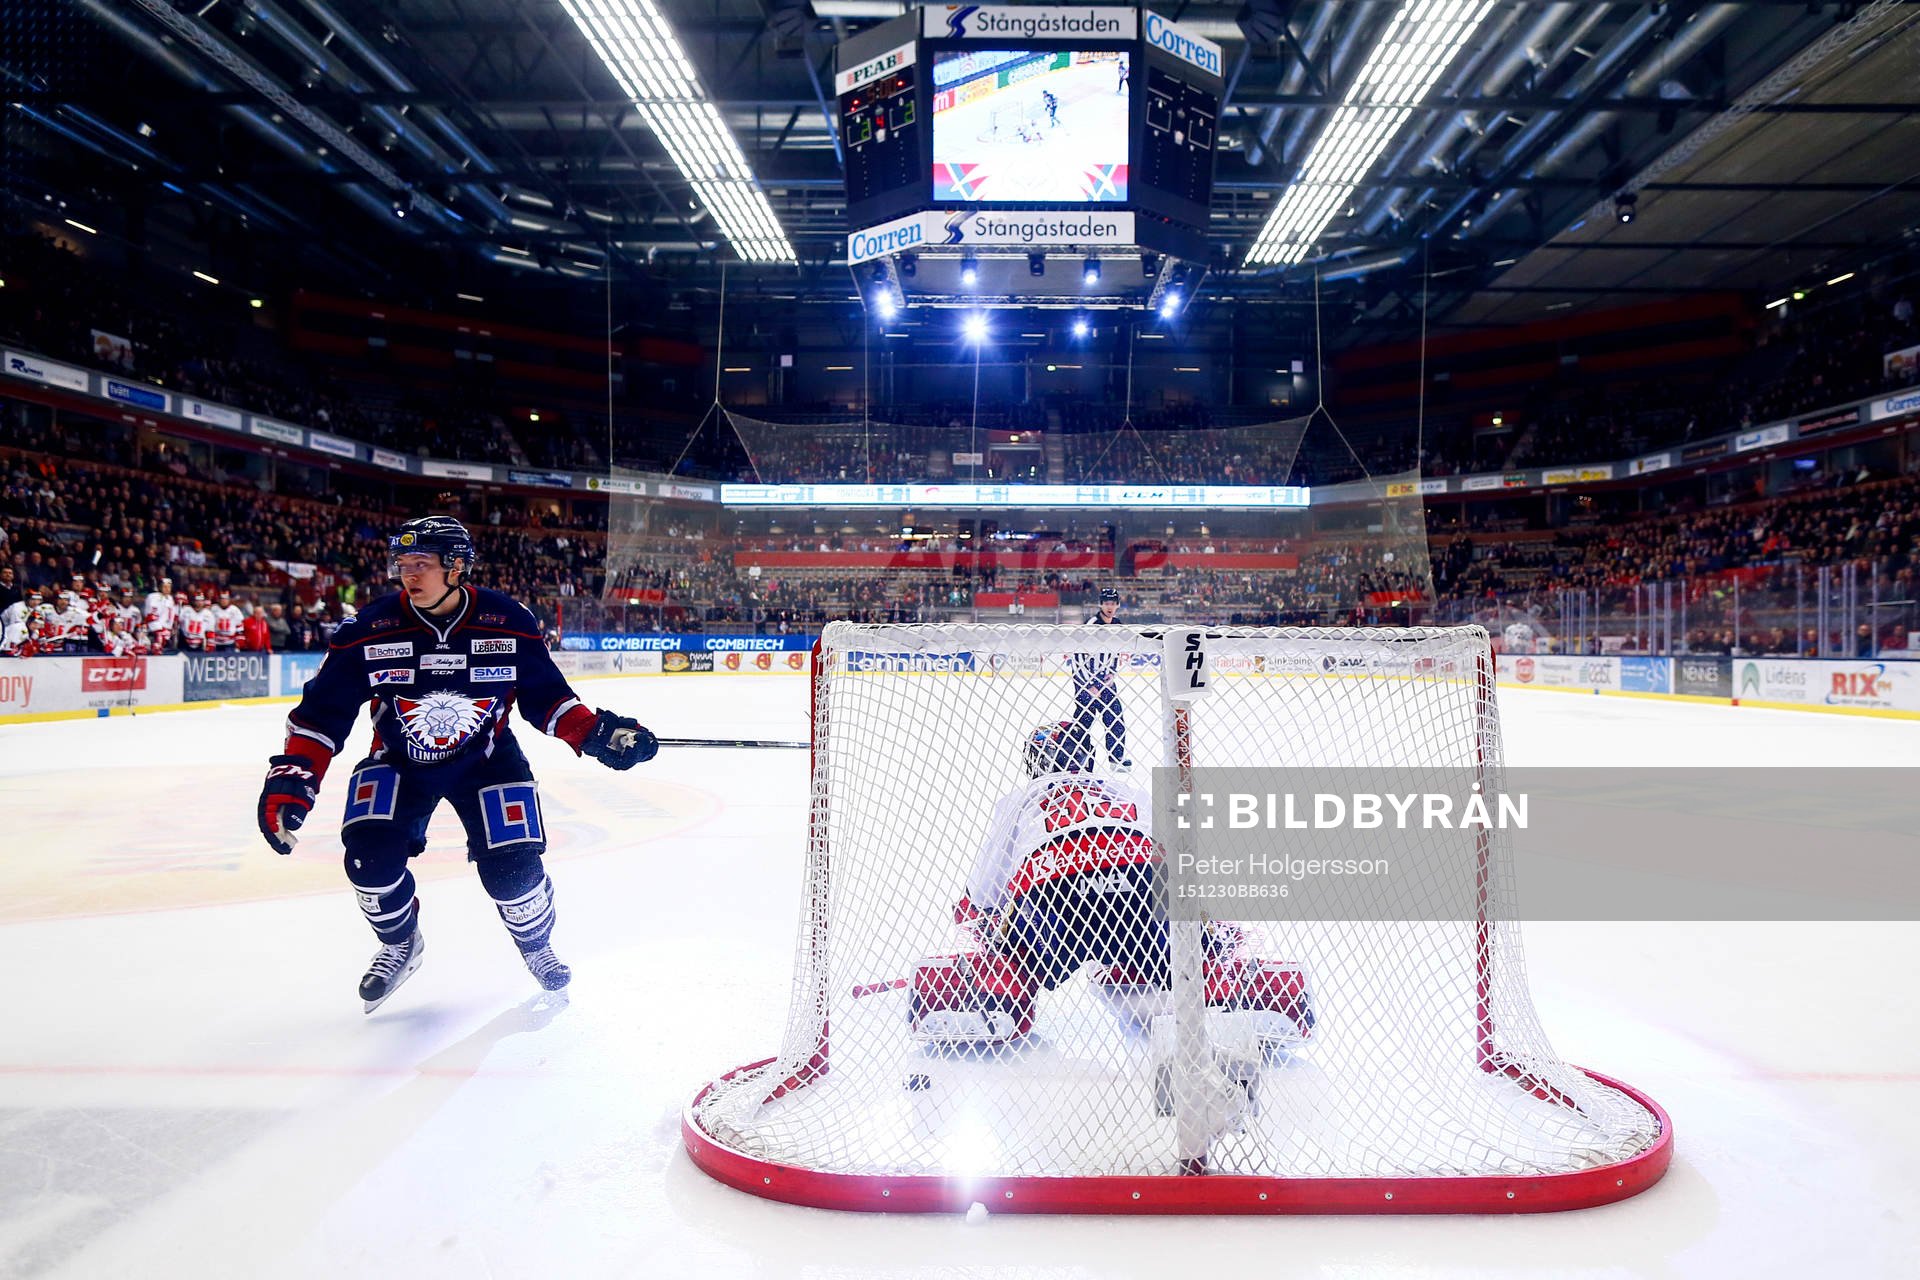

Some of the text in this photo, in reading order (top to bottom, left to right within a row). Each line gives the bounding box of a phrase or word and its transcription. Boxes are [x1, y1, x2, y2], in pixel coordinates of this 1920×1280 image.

[976, 12, 1120, 37] Stångåstaden
[1146, 15, 1221, 74] Corren
[853, 55, 897, 82] PEAB
[852, 221, 923, 260] Corren
[974, 217, 1118, 241] Stångåstaden
[474, 643, 513, 653] LEGENDS
[601, 638, 681, 650] COMBITECH
[706, 638, 784, 650] COMBITECH
[474, 667, 512, 676] SMG
[1184, 633, 1206, 688] SHL
[88, 667, 140, 683] CCM
[1831, 672, 1878, 697] RIX
